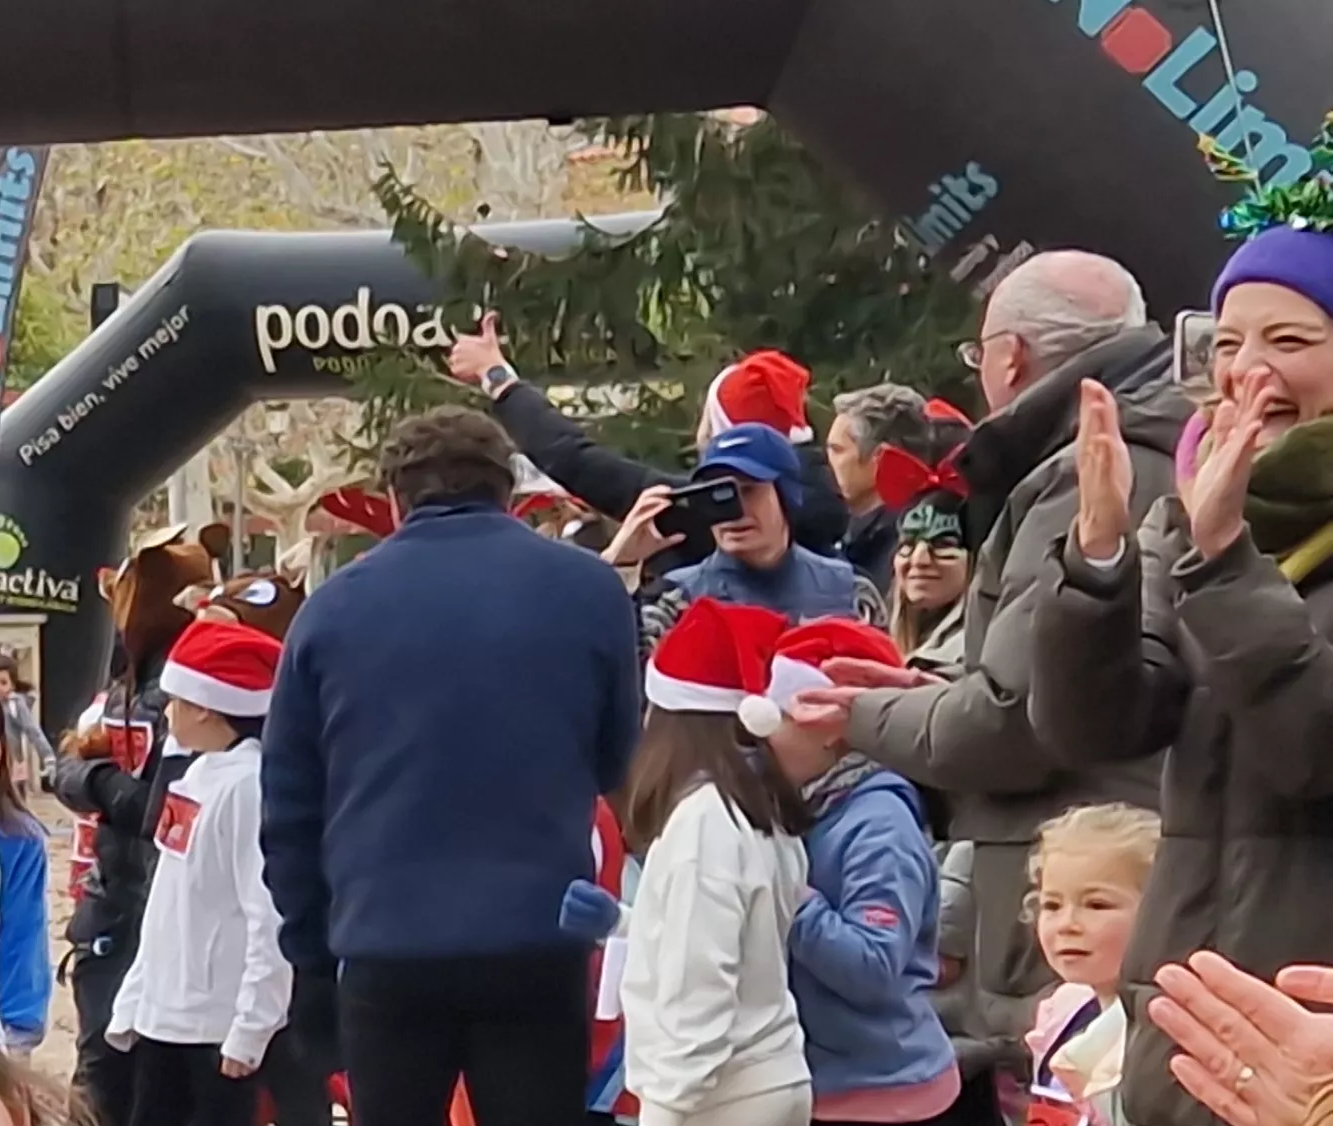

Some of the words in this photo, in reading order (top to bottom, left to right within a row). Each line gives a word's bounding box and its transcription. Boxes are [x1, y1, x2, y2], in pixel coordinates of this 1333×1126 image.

[19, 427, 61, 466] Pisa
[57, 391, 106, 431] bien,
[102, 354, 139, 391] vive
[138, 304, 189, 361] mejor
